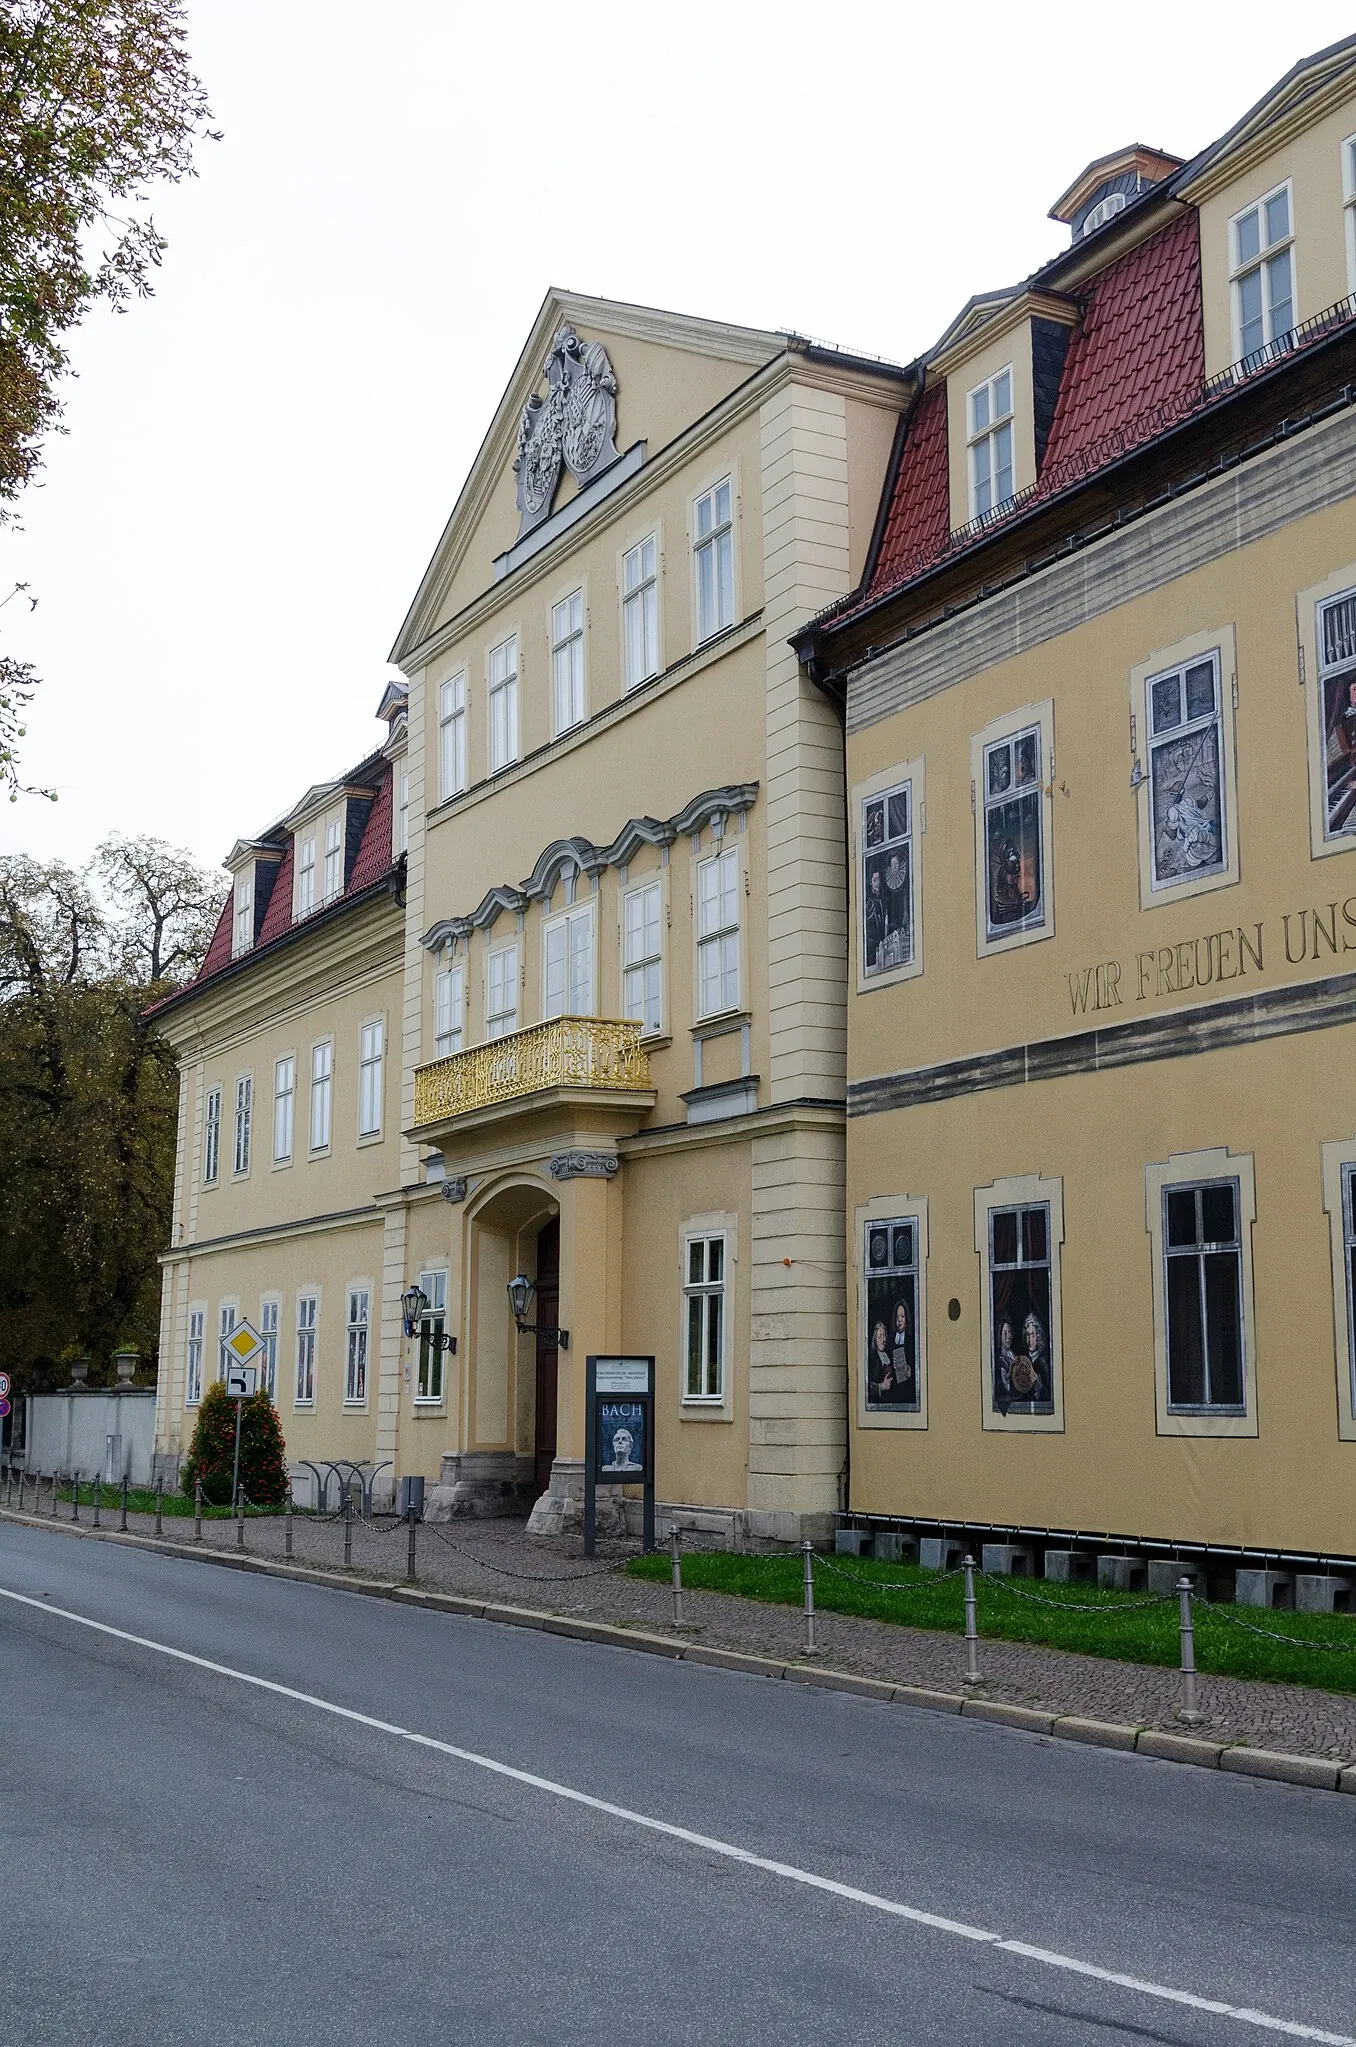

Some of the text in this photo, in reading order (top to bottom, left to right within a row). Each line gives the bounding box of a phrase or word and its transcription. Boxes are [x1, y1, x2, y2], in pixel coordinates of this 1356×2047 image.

[1063, 960, 1123, 1015] WIR
[1135, 922, 1264, 1001] FREUEN
[602, 1403, 642, 1416] BACH
